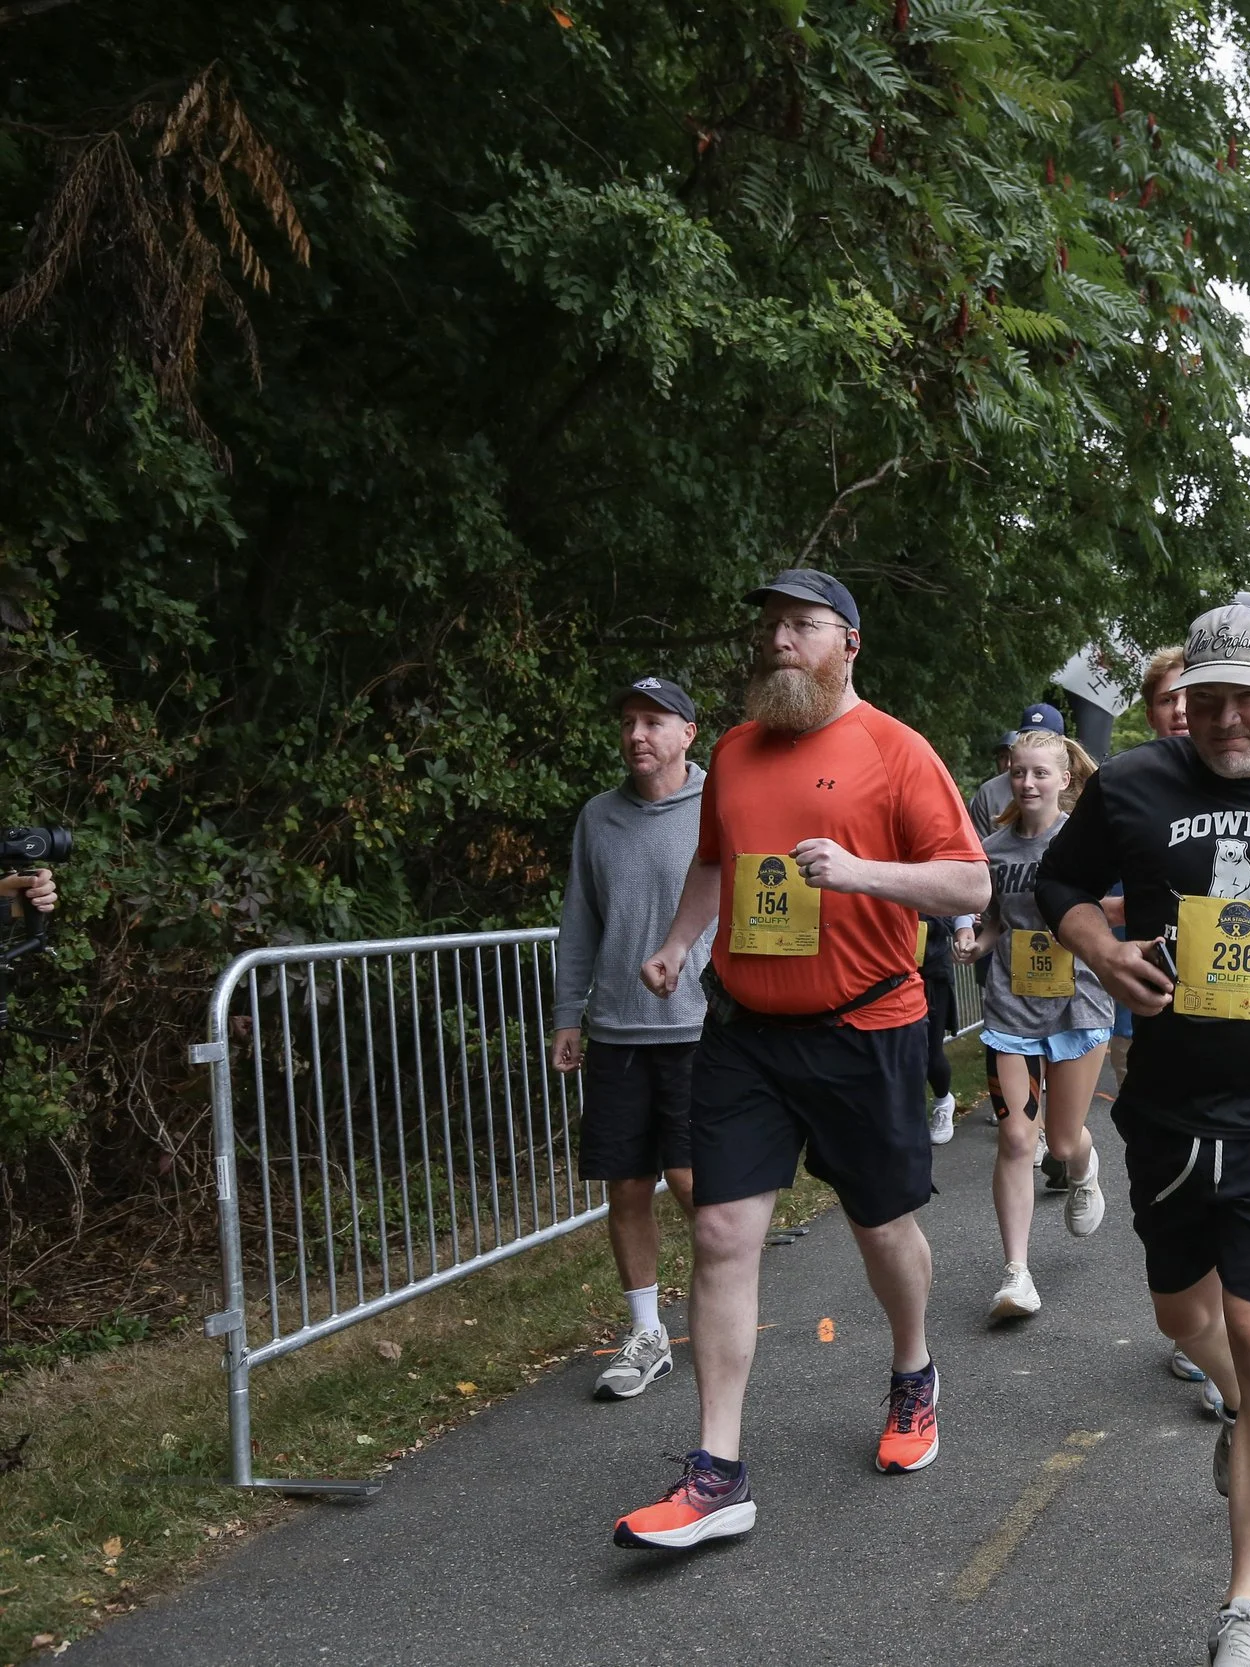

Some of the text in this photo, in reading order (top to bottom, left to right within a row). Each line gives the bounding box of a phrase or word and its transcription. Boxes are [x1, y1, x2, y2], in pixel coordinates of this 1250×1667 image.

[1187, 628, 1213, 660] New
[756, 891, 788, 915] 154
[757, 916, 790, 924] DUFFY
[1029, 955, 1053, 972] 155
